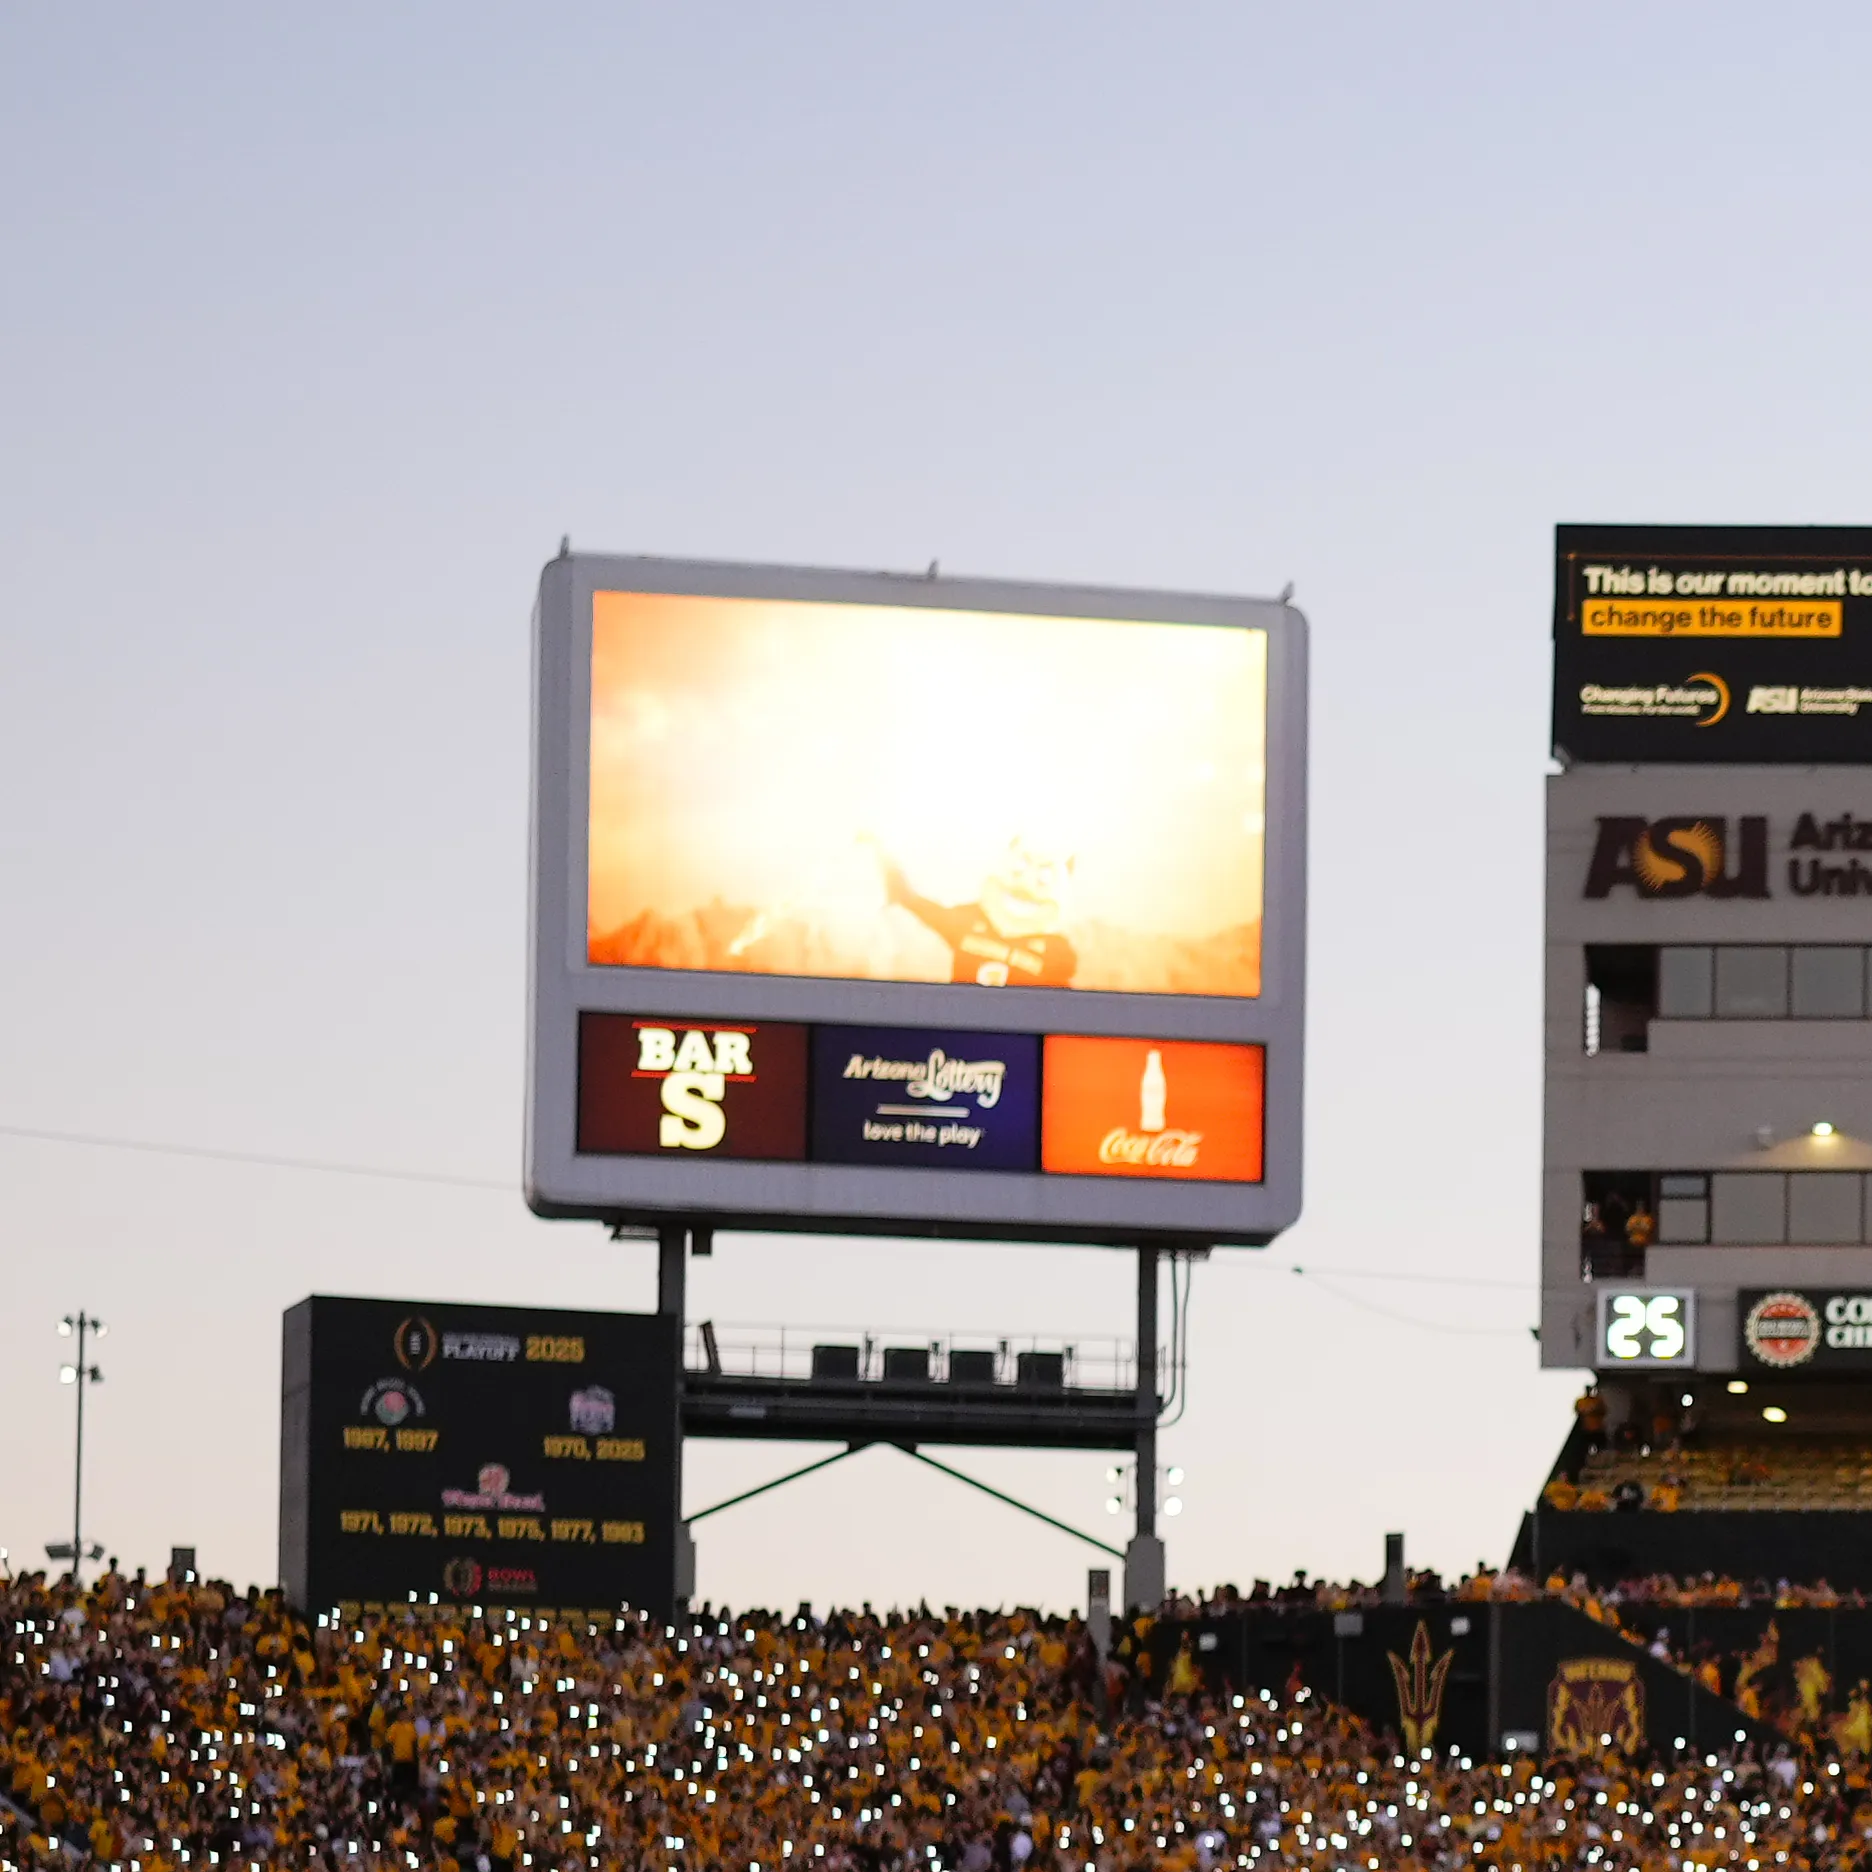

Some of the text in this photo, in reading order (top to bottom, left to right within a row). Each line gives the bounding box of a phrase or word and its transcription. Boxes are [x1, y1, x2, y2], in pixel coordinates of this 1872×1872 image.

[1583, 565, 1645, 595] This
[1647, 568, 1674, 595] is
[1676, 572, 1726, 595] our
[1727, 569, 1848, 596] moment
[1591, 605, 1833, 632] change the future
[1583, 813, 1772, 902] ASU
[637, 1026, 754, 1075] BAR
[659, 1071, 727, 1150] S
[862, 1119, 983, 1150] love the play
[1607, 1295, 1684, 1359] 25
[526, 1336, 585, 1363] 2025
